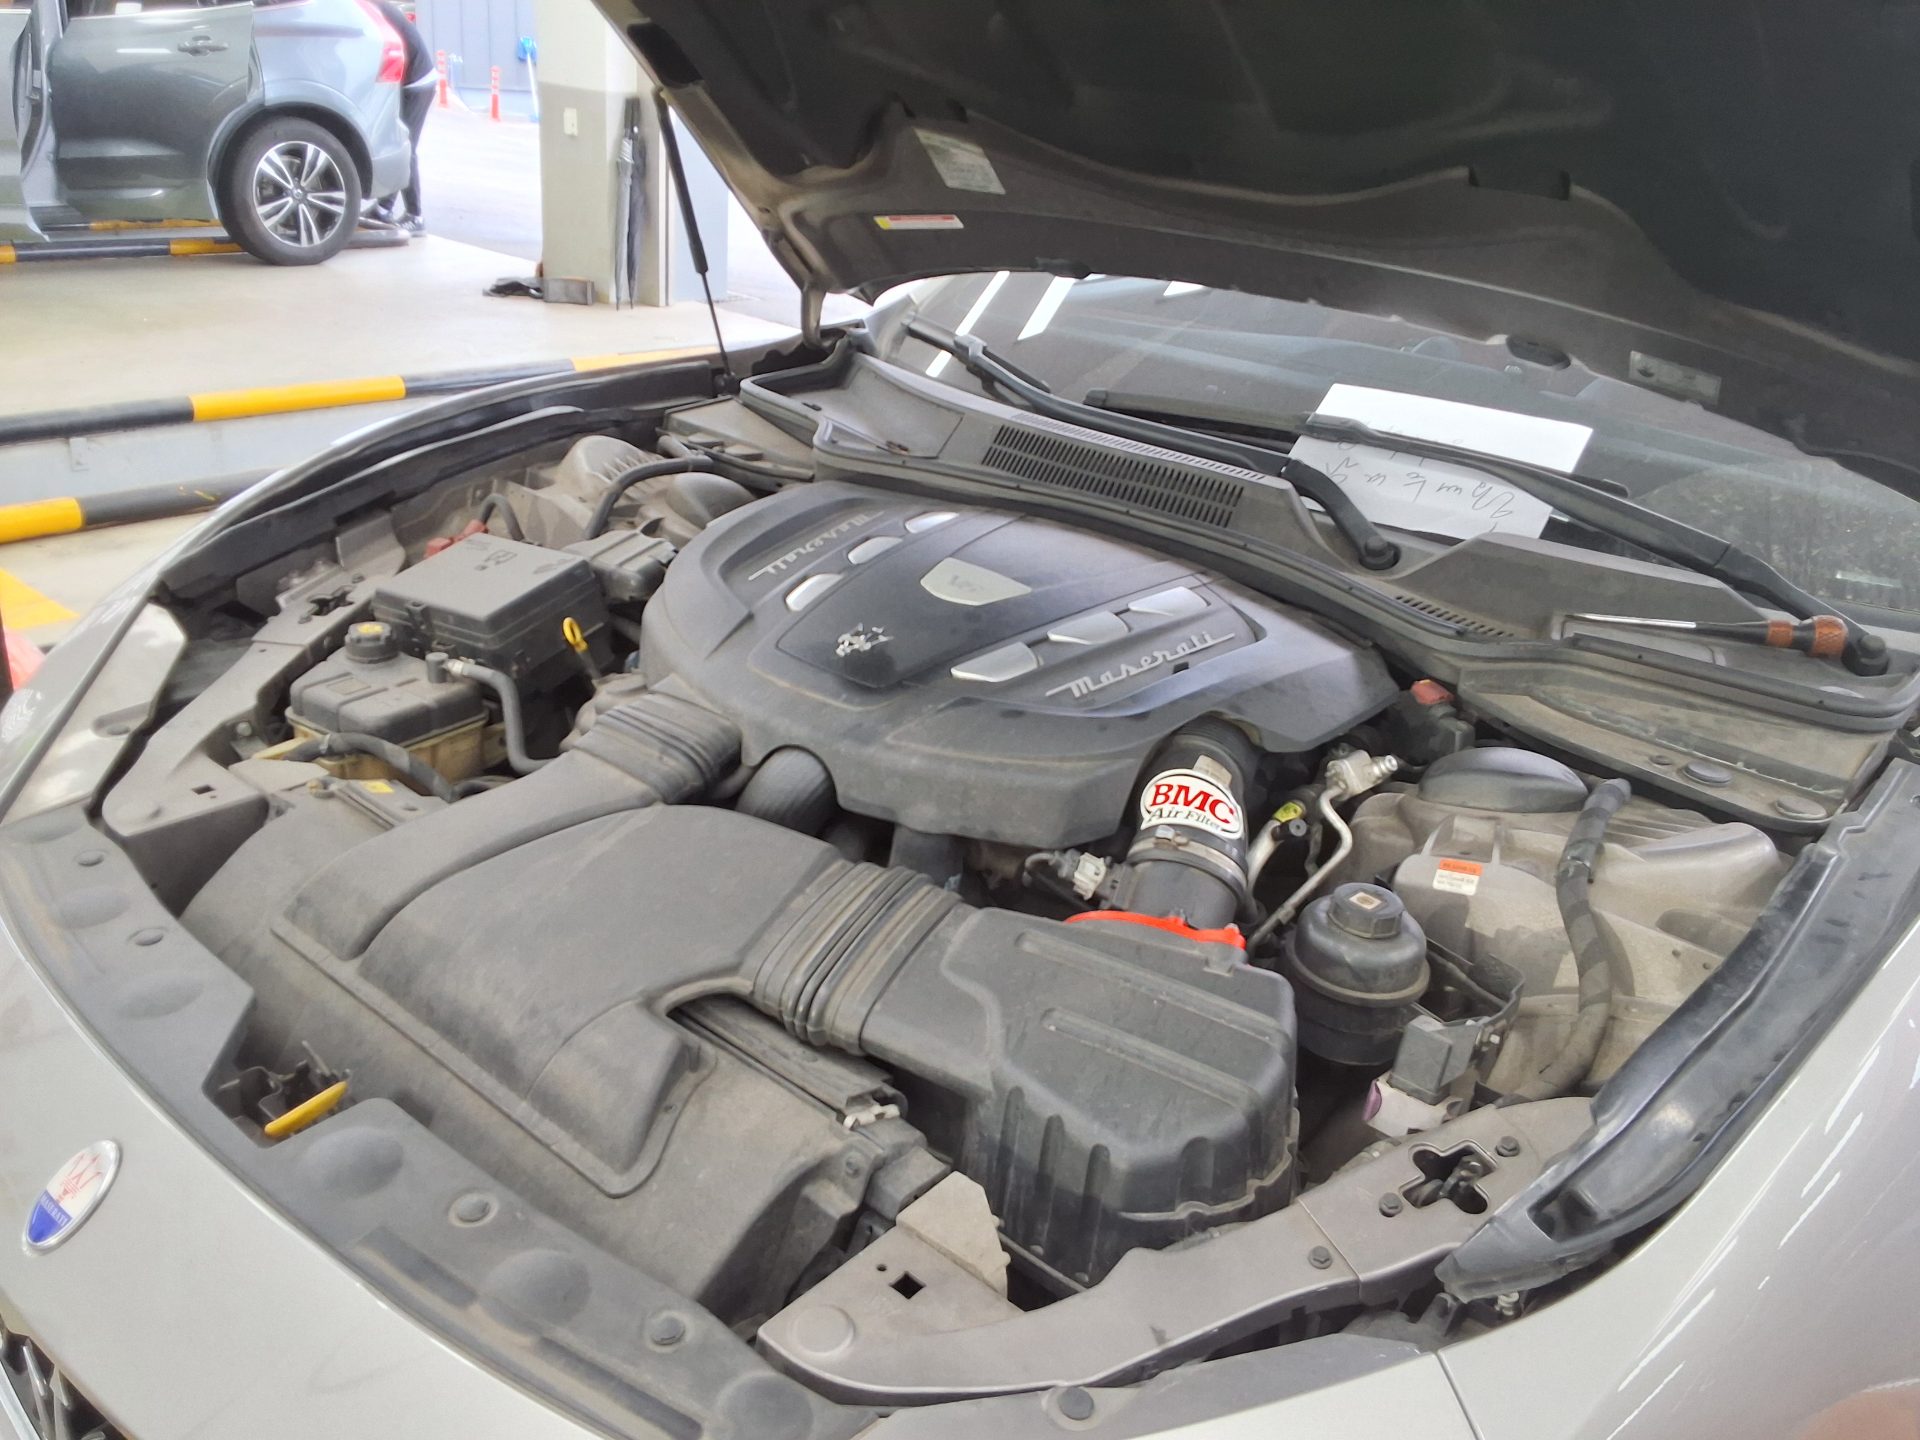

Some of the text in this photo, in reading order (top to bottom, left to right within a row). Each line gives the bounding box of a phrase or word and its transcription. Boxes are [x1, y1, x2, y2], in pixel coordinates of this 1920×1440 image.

[1045, 631, 1235, 698] Maserati
[1148, 807, 1221, 832] Air Filter
[1150, 783, 1234, 824] BMC
[40, 1193, 68, 1227] MASERATI
